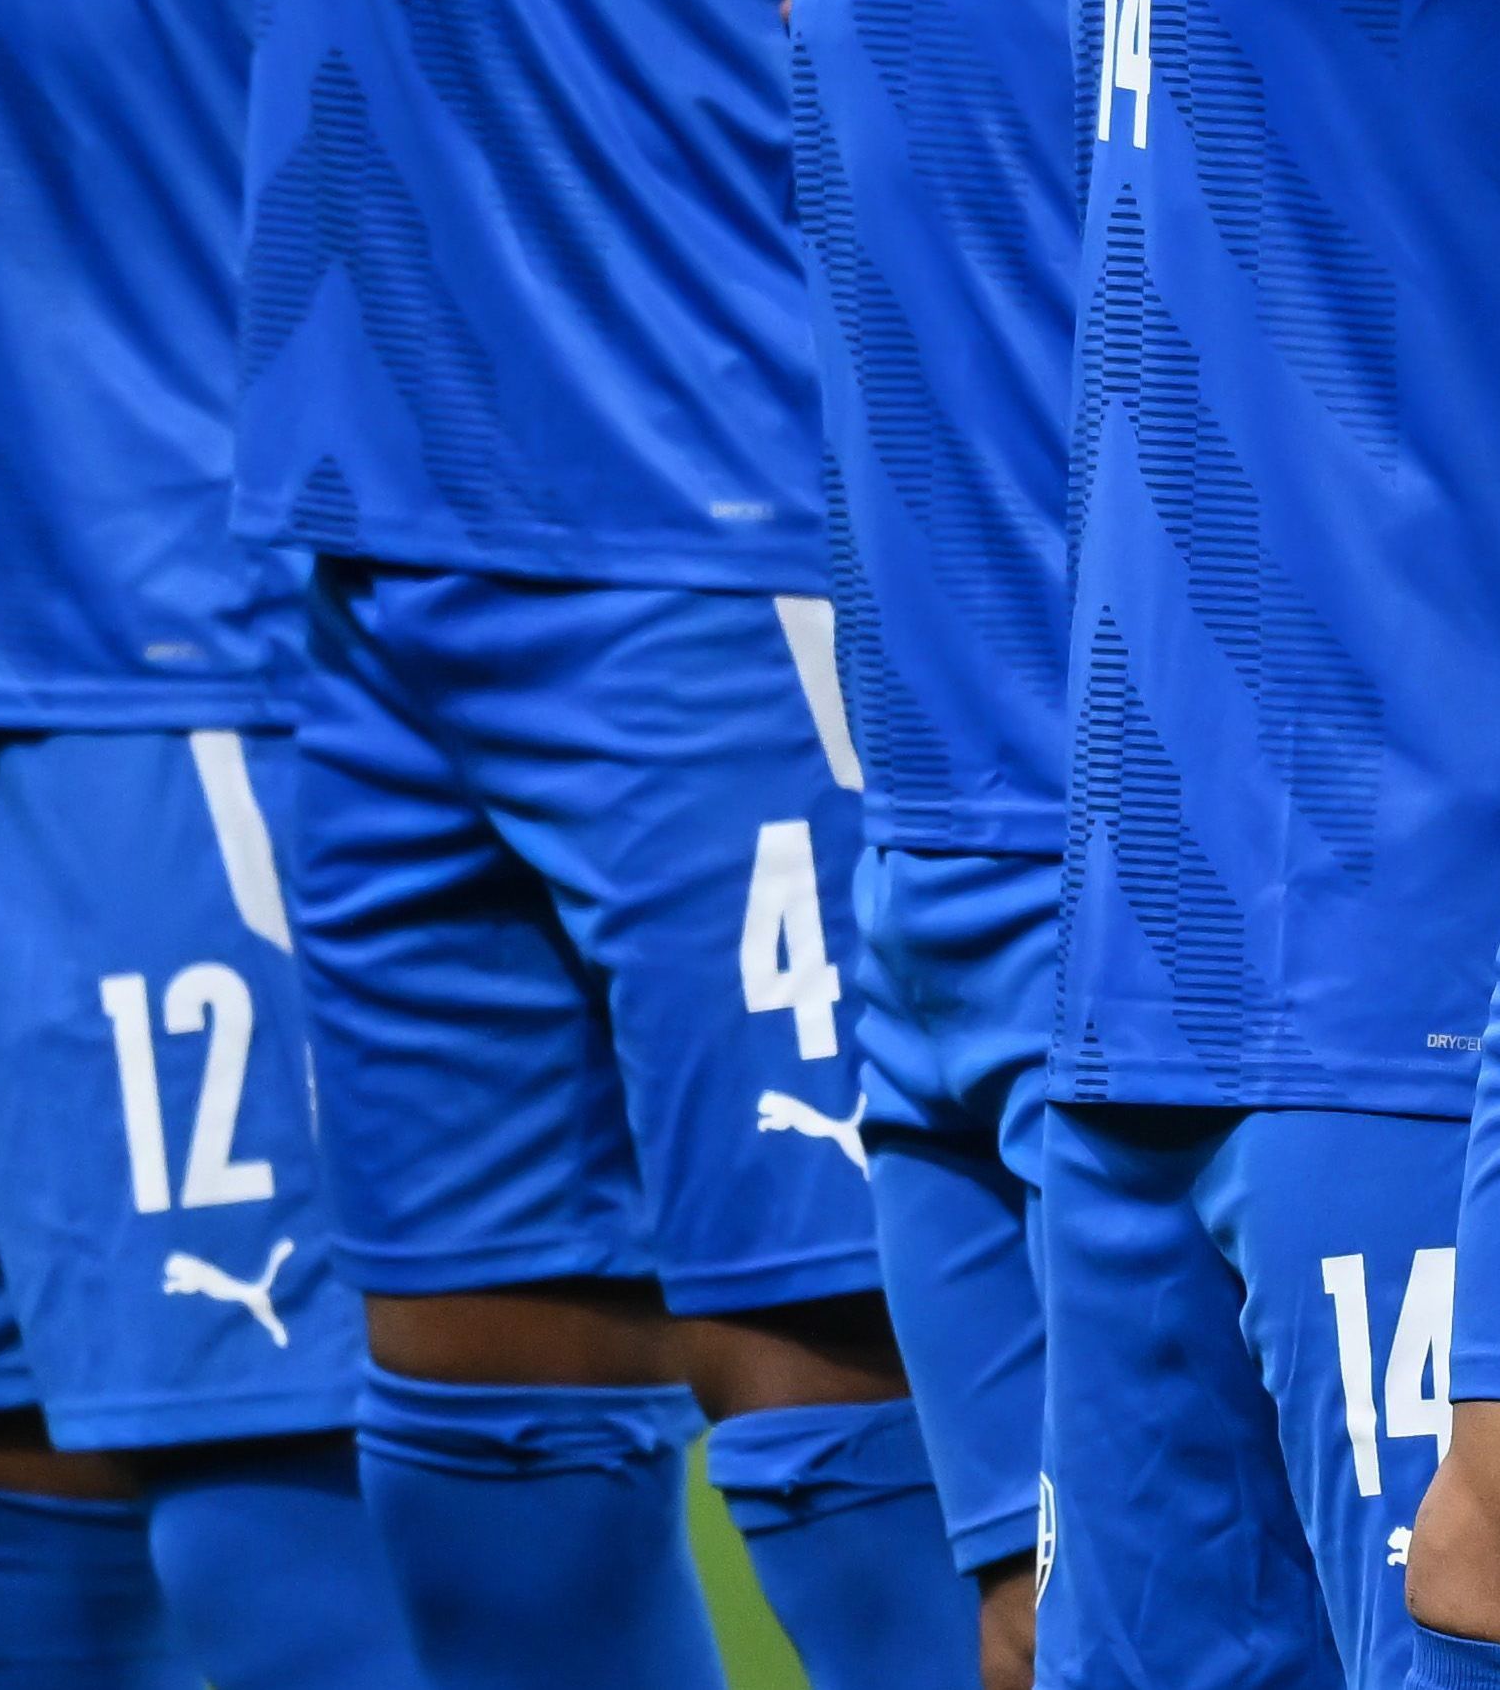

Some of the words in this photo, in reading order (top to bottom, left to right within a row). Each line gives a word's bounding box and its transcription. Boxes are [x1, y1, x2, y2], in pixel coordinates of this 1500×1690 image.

[739, 819, 842, 1061] 4
[1426, 1033, 1483, 1051] DRYCEL
[100, 963, 274, 1214] 12
[1320, 1246, 1457, 1498] 14
